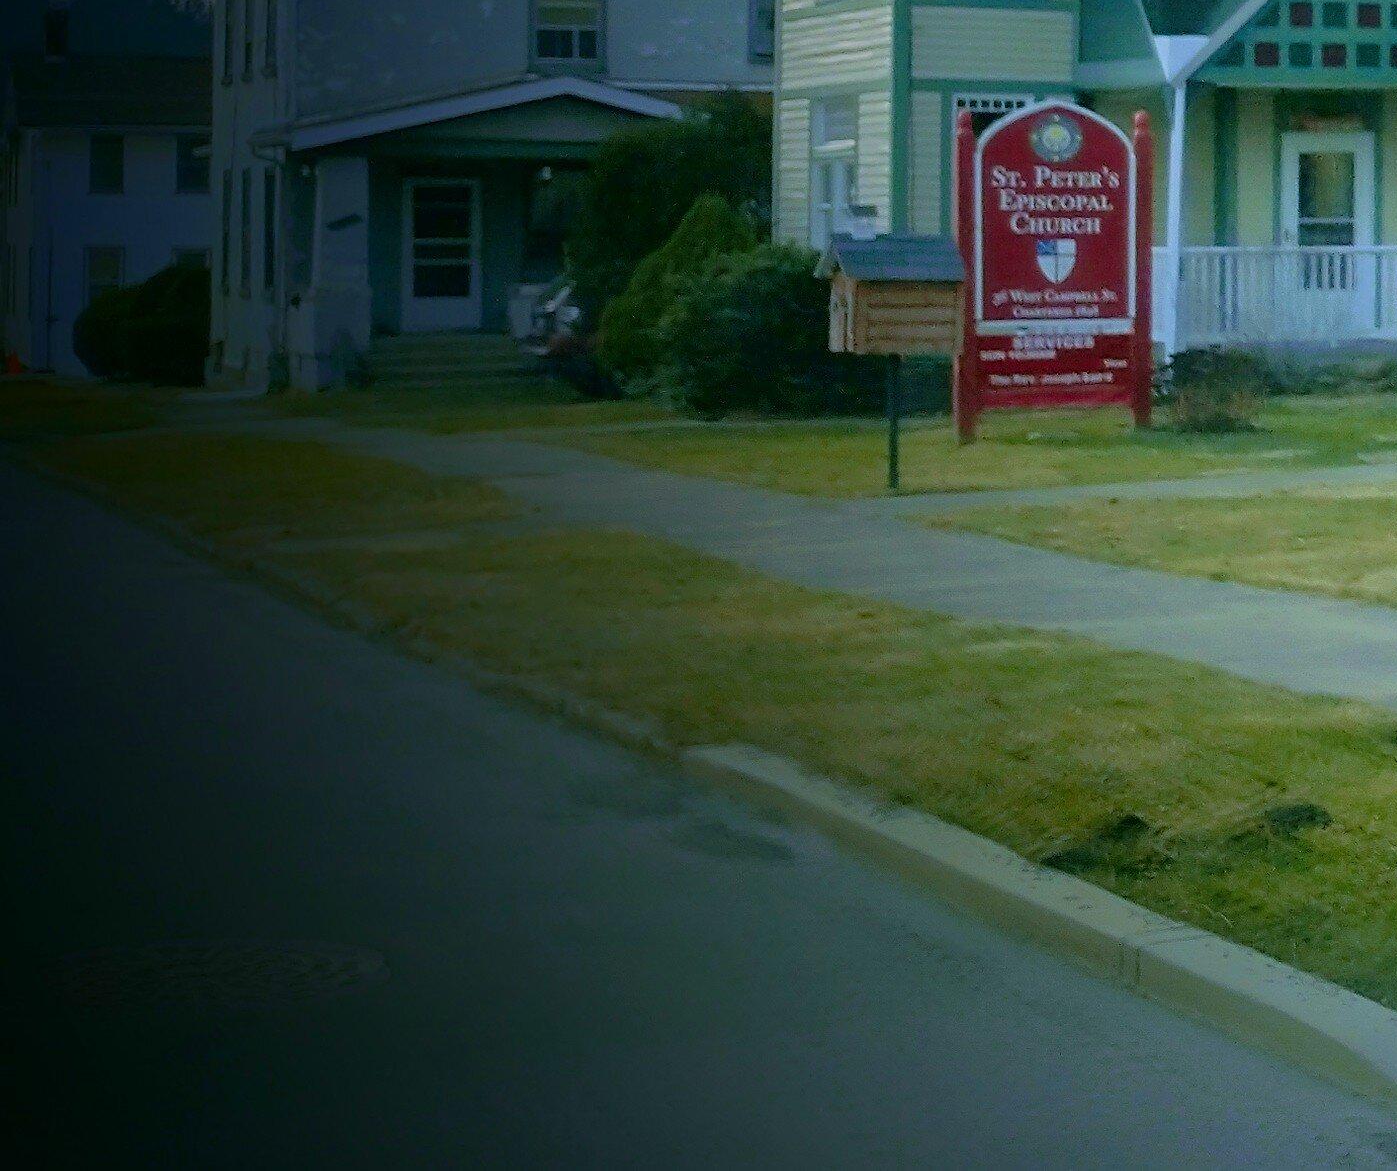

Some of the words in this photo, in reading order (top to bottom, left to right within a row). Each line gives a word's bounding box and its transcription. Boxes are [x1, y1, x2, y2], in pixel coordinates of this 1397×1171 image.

[1033, 165, 1120, 188] PETER'S
[999, 188, 1114, 210] EPISCOPAL
[1010, 211, 1101, 234] CHURCH
[1012, 335, 1095, 349] SERVICES
